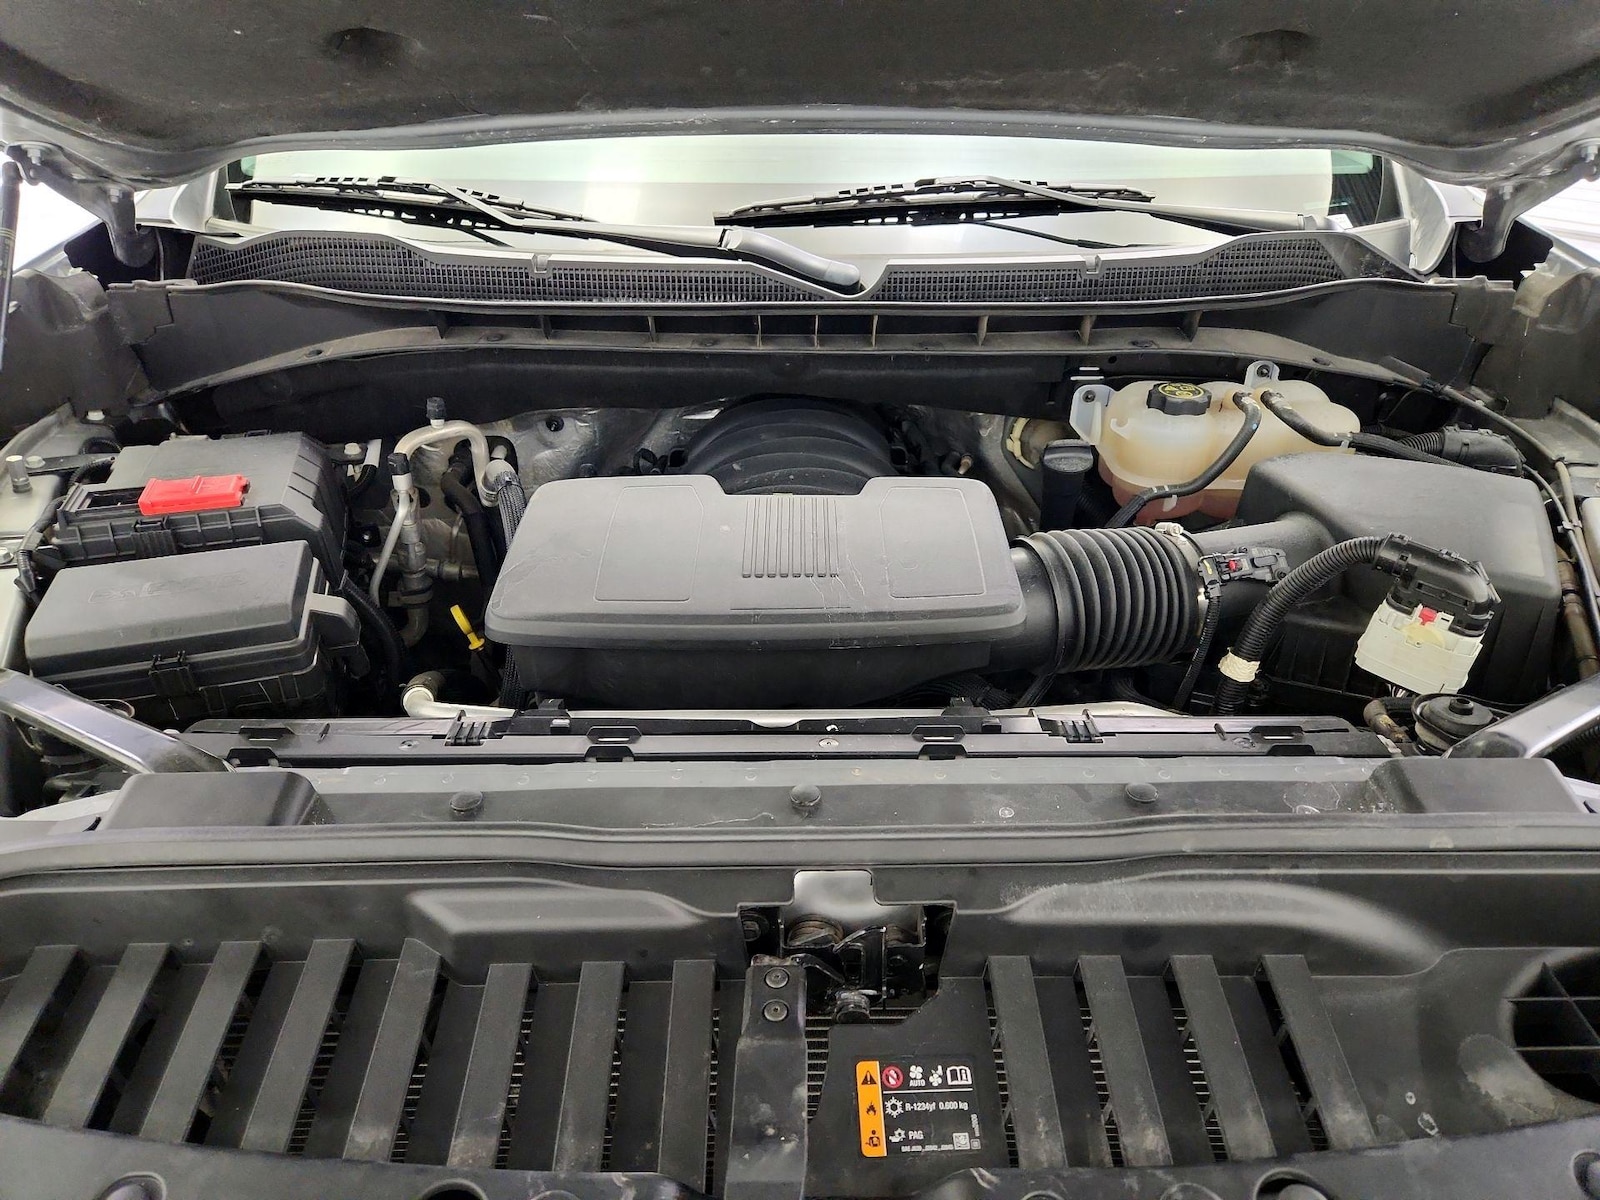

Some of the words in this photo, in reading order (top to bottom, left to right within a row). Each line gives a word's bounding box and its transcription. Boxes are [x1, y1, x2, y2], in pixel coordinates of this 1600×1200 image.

[909, 1079, 926, 1087] AUTO
[905, 1101, 936, 1113] R-1234yf
[958, 1101, 969, 1111] kg
[908, 1130, 924, 1140] PAG
